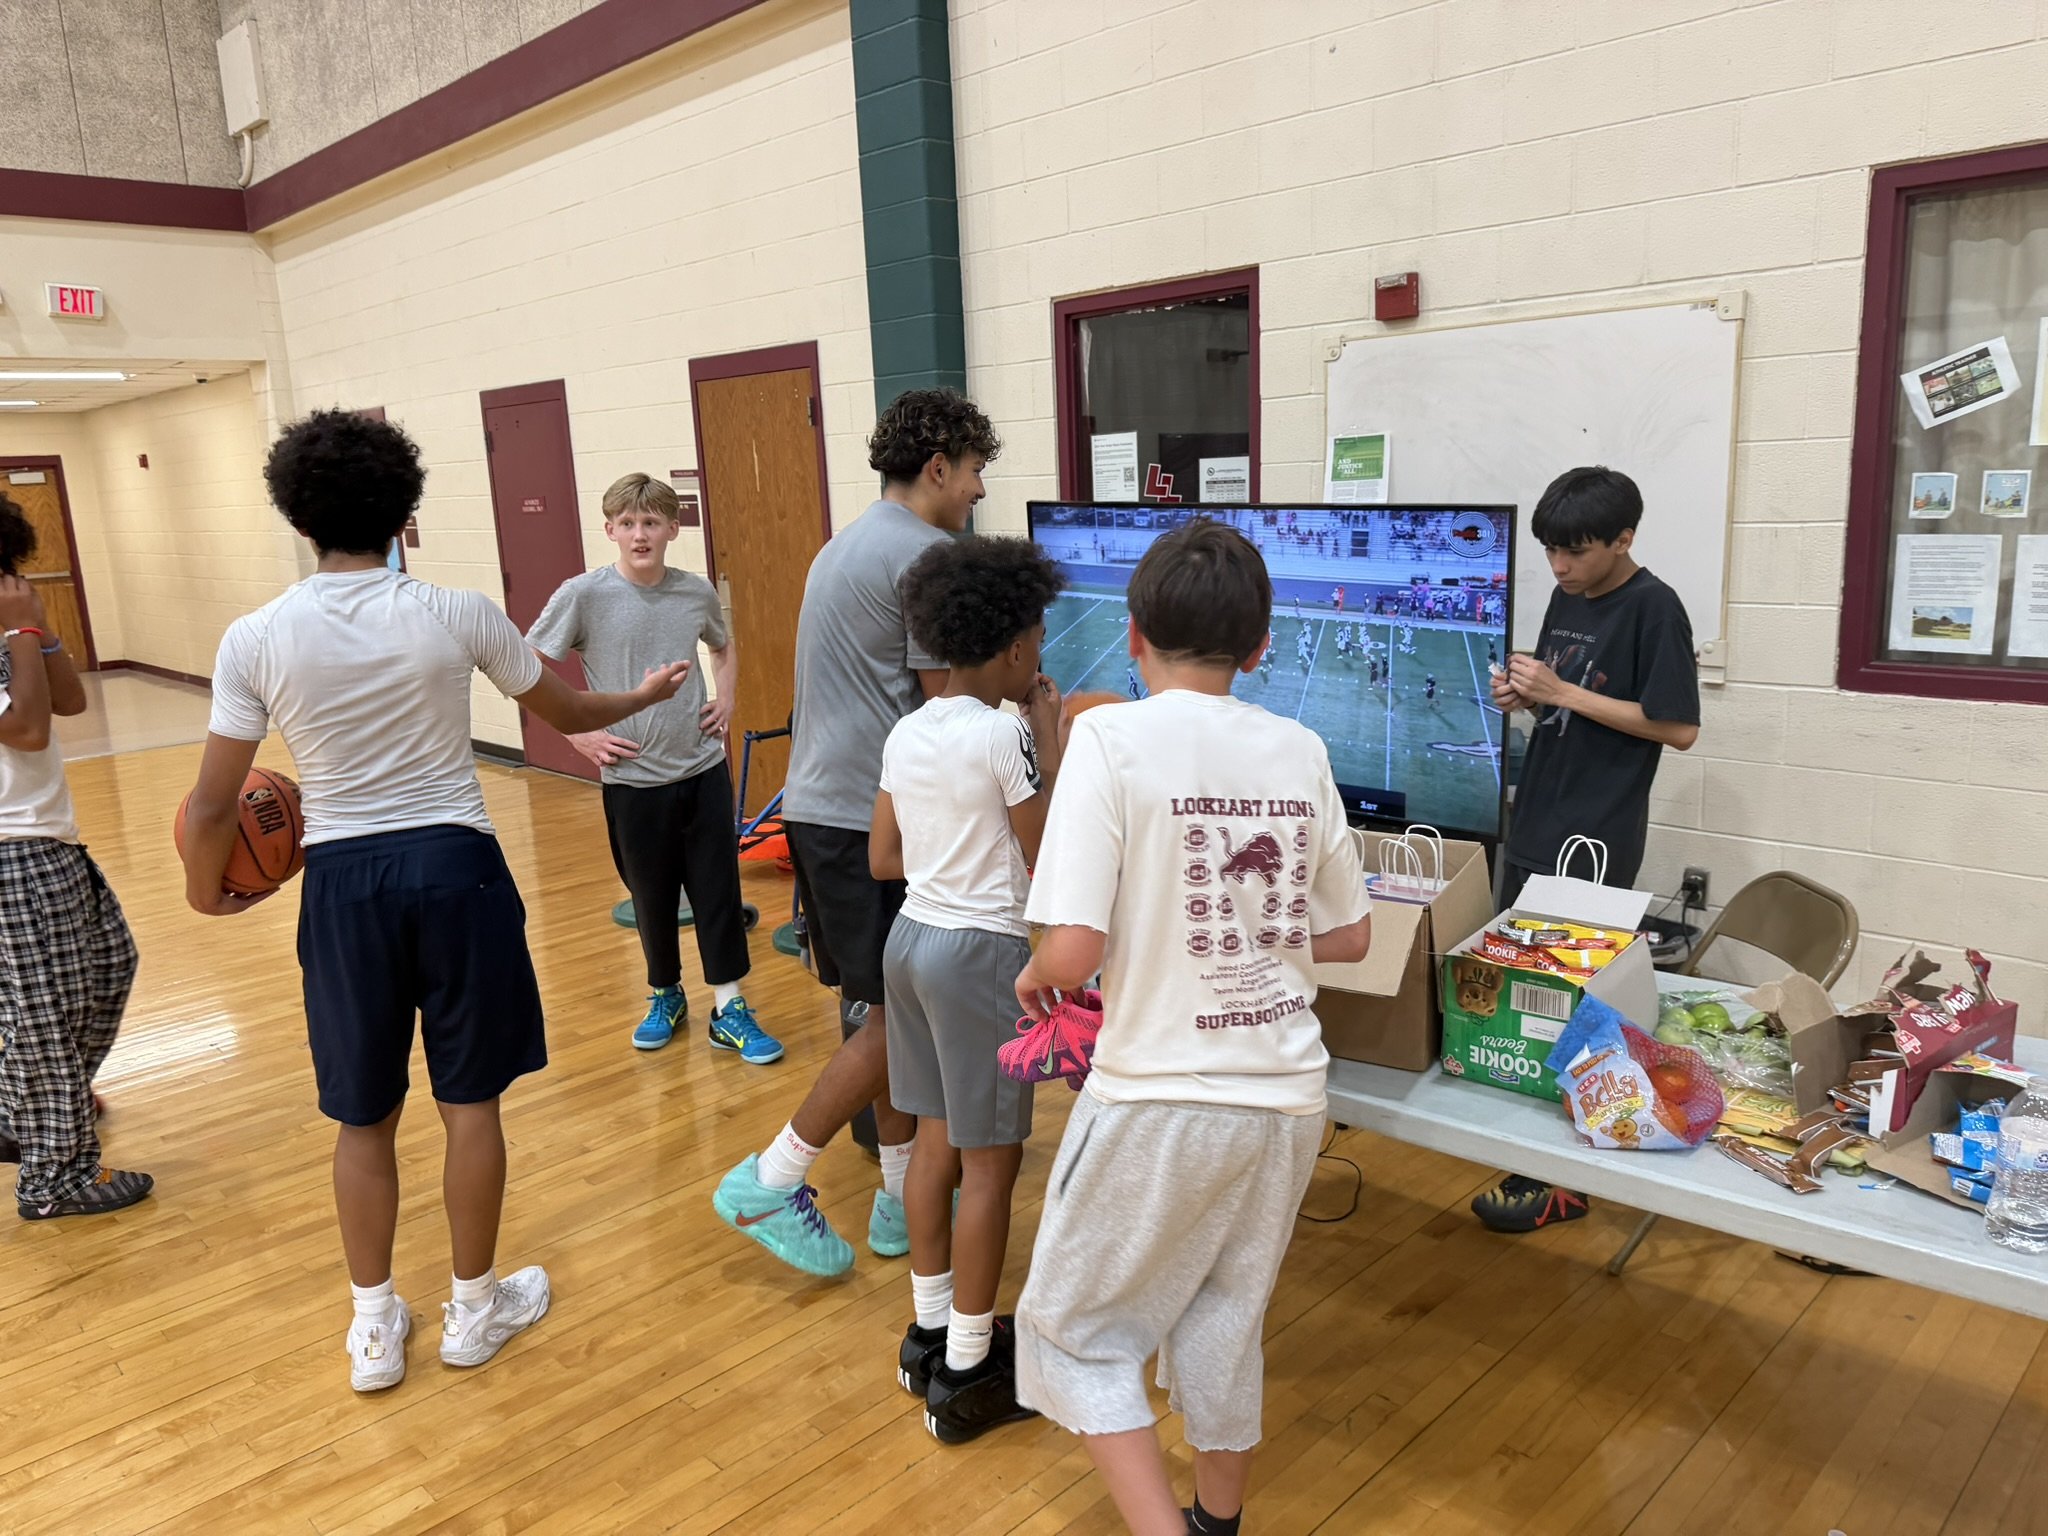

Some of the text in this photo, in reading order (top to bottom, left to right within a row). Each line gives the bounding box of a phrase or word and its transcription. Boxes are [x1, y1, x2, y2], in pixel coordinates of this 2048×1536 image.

[59, 287, 95, 315] EXIT
[251, 799, 287, 836] NBA
[1267, 799, 1315, 818] LIONS
[1360, 800, 1378, 811] 1ST
[1480, 1034, 1529, 1056] Bears
[1469, 1045, 1543, 1080] COOKIE
